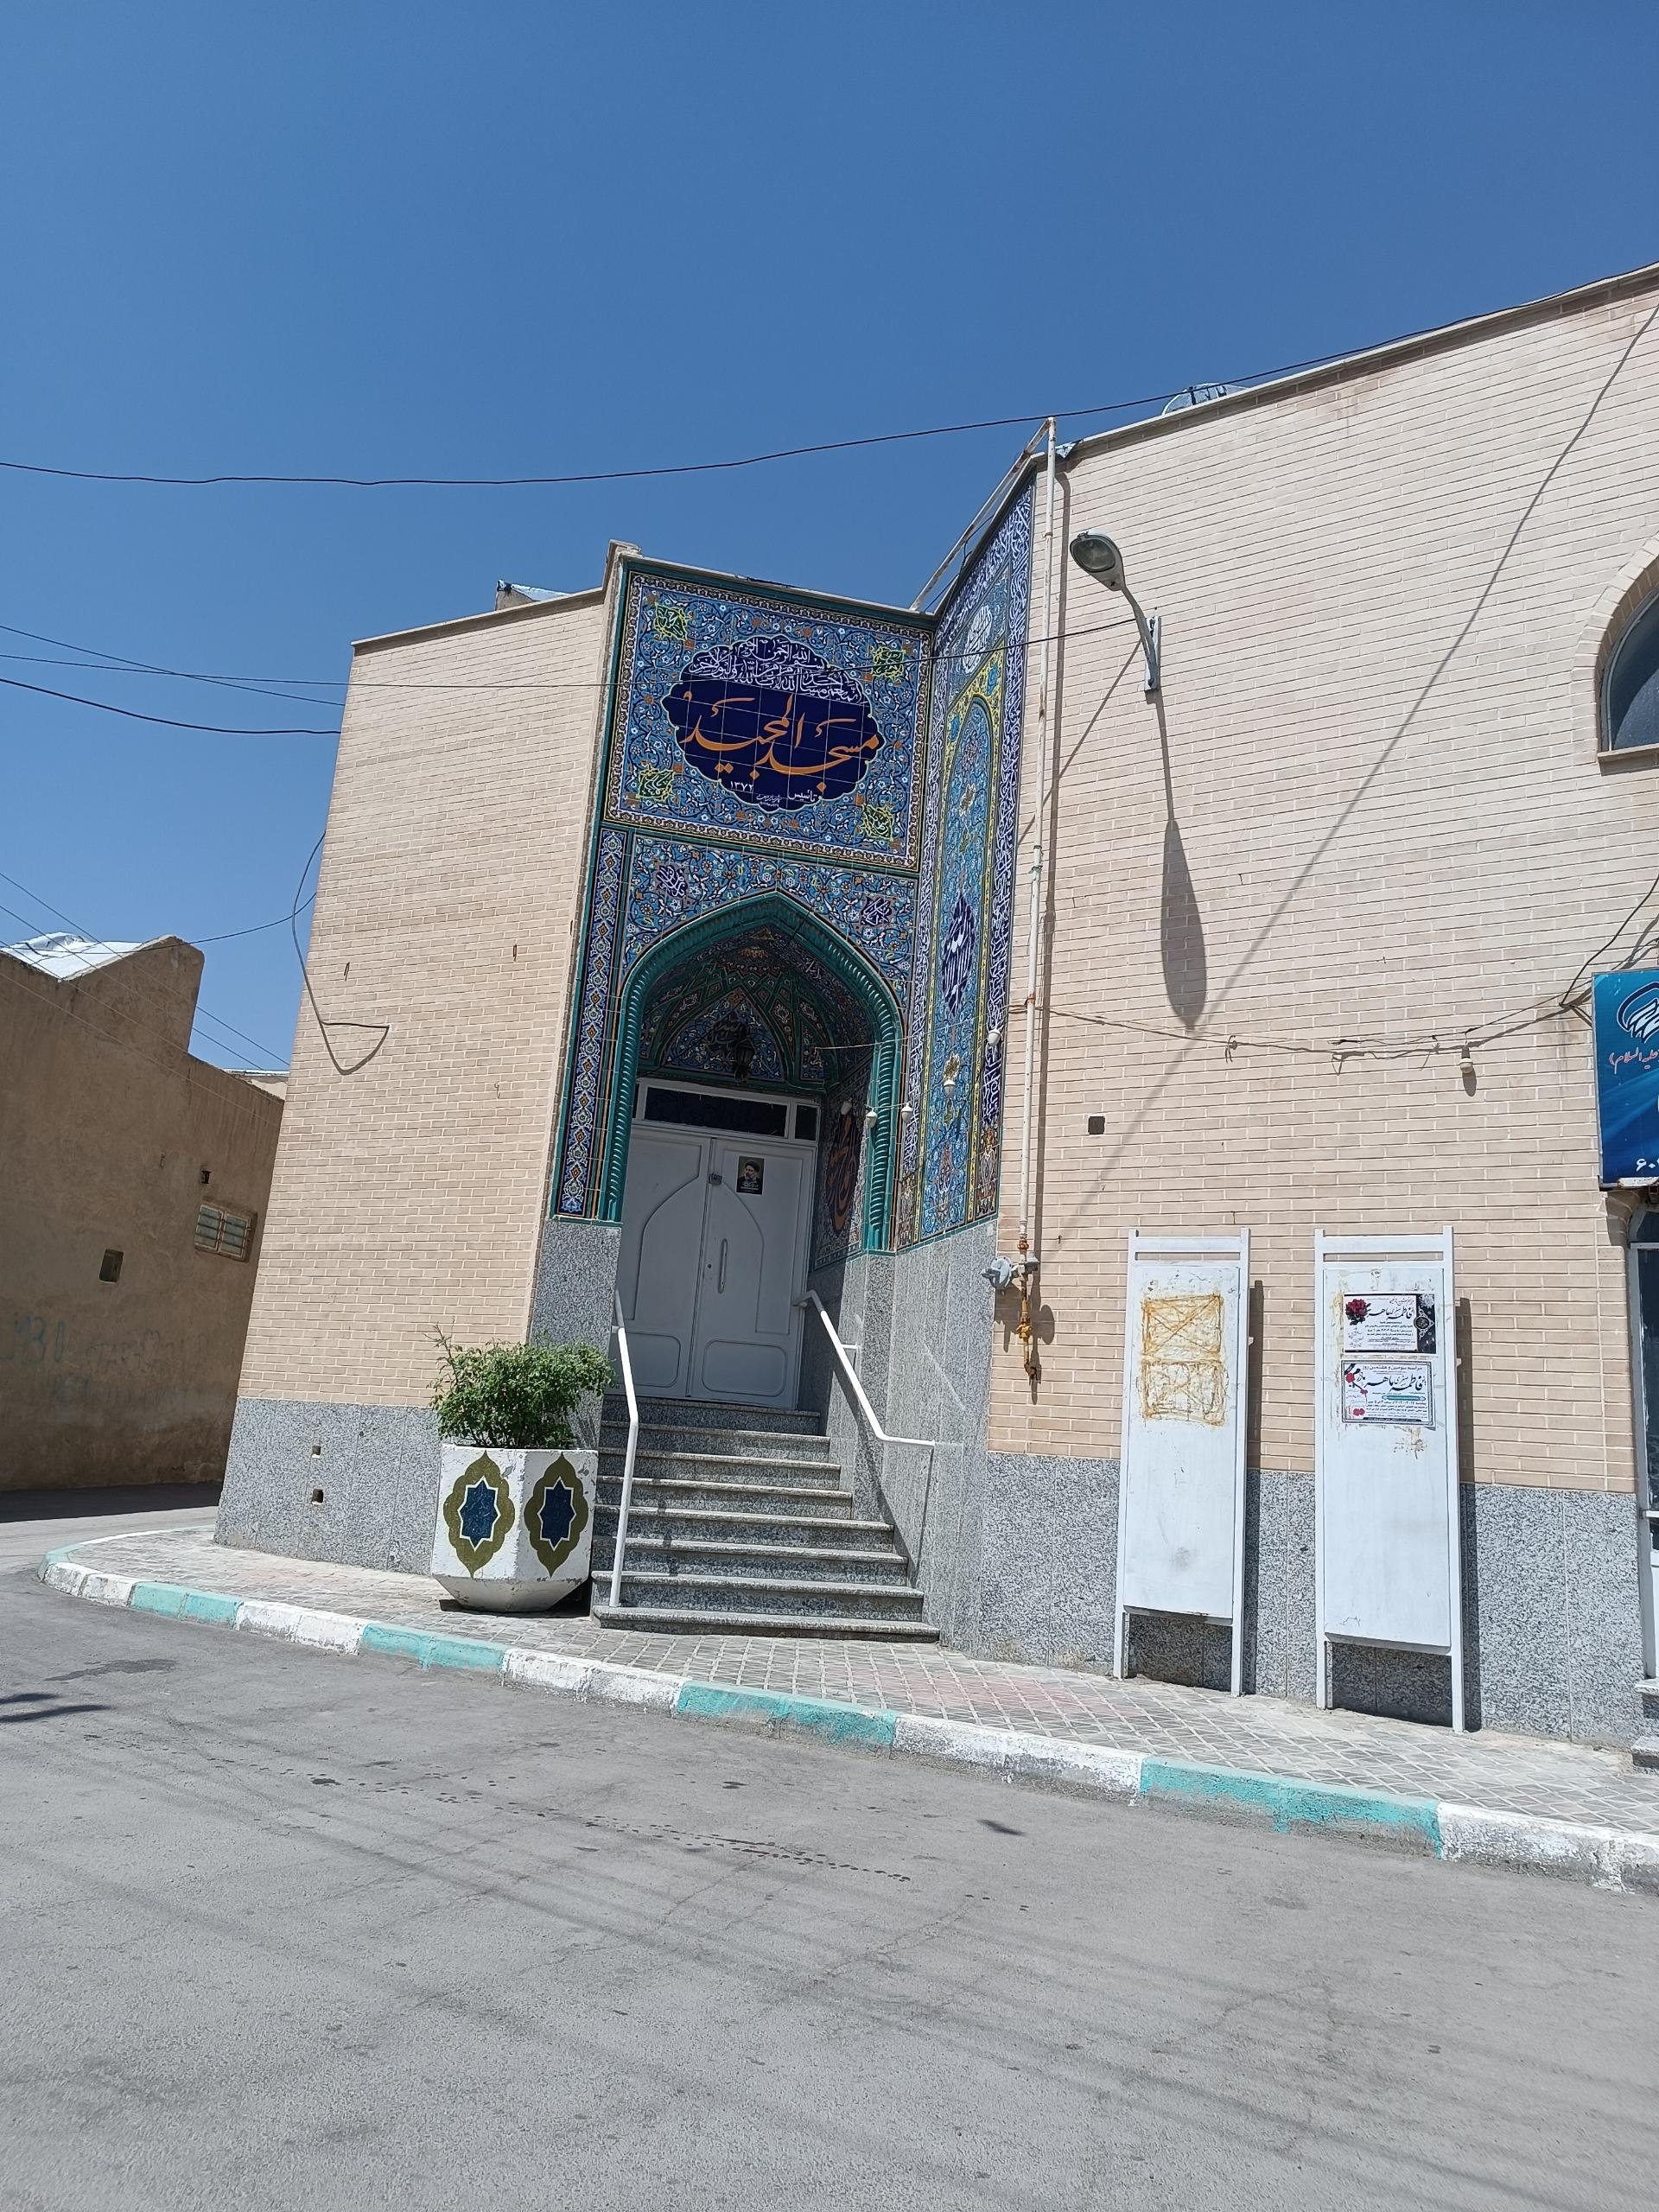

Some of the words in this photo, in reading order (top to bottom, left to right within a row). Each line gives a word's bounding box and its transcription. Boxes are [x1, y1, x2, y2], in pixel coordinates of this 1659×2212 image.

[792, 645, 811, 664] الله
[679, 692, 805, 780] المجید
[755, 718, 880, 792] مسجد
[1636, 1158, 1659, 1172] ۶۰
[1389, 1373, 1422, 1392] فاطمه
